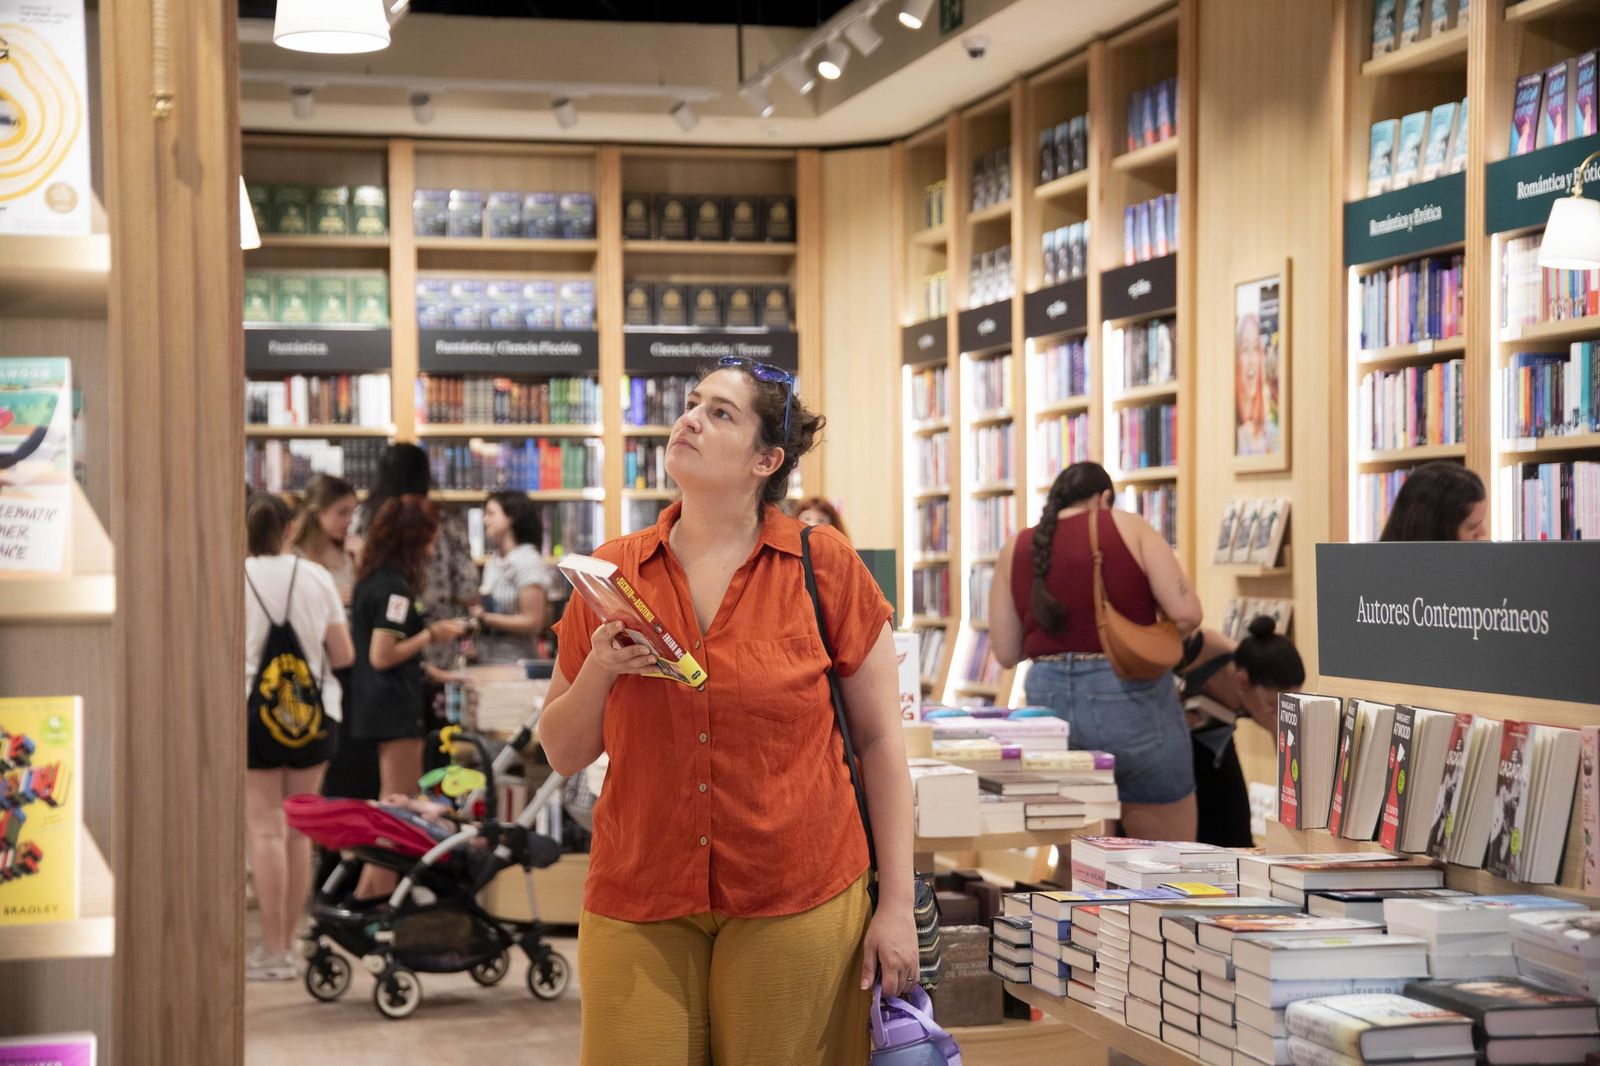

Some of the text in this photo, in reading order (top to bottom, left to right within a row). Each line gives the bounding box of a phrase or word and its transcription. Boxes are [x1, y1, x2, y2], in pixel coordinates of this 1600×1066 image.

[1516, 170, 1566, 200] Romántica
[1356, 595, 1549, 640] Autores Contemporáneos
[1280, 711, 1298, 727] ATWOOD
[1393, 722, 1411, 740] ATWOOD
[3, 903, 60, 915] BRADLEY
